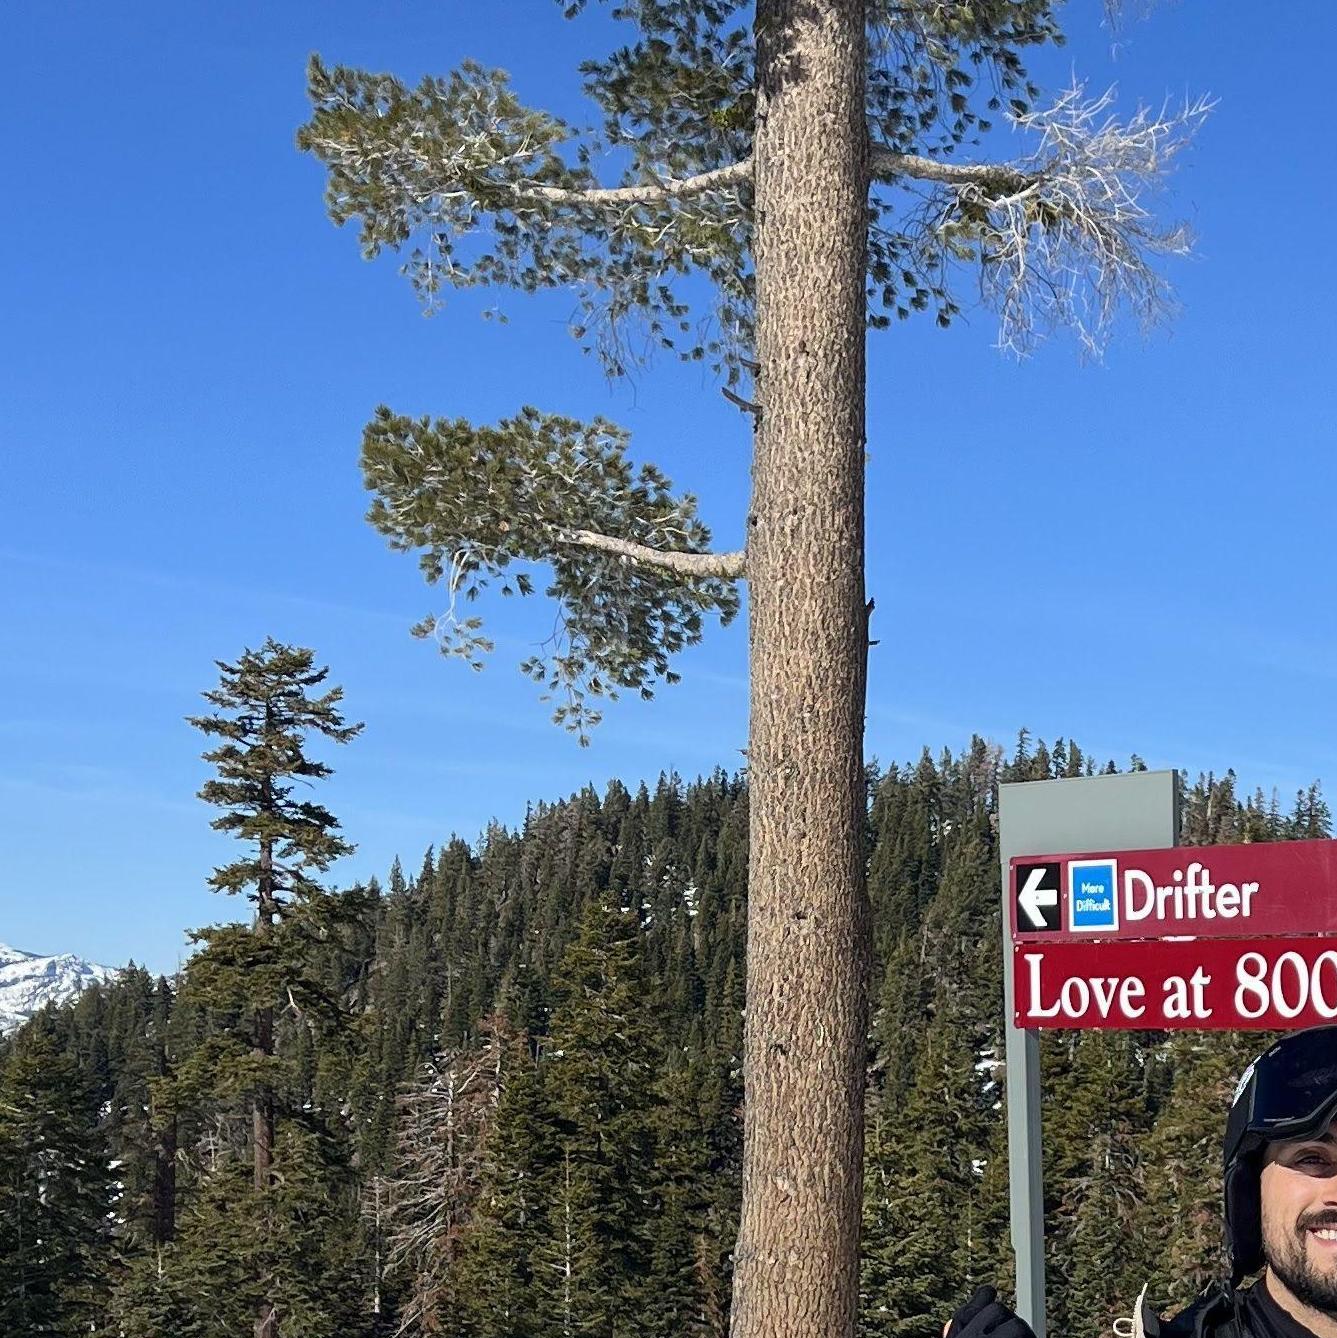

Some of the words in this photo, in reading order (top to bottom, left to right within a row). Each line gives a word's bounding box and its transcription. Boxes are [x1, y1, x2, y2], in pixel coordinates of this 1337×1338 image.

[1076, 898, 1111, 912] Difficult
[1124, 862, 1260, 921] Drifter
[1023, 953, 1146, 1019] Love
[1162, 965, 1212, 1019] at
